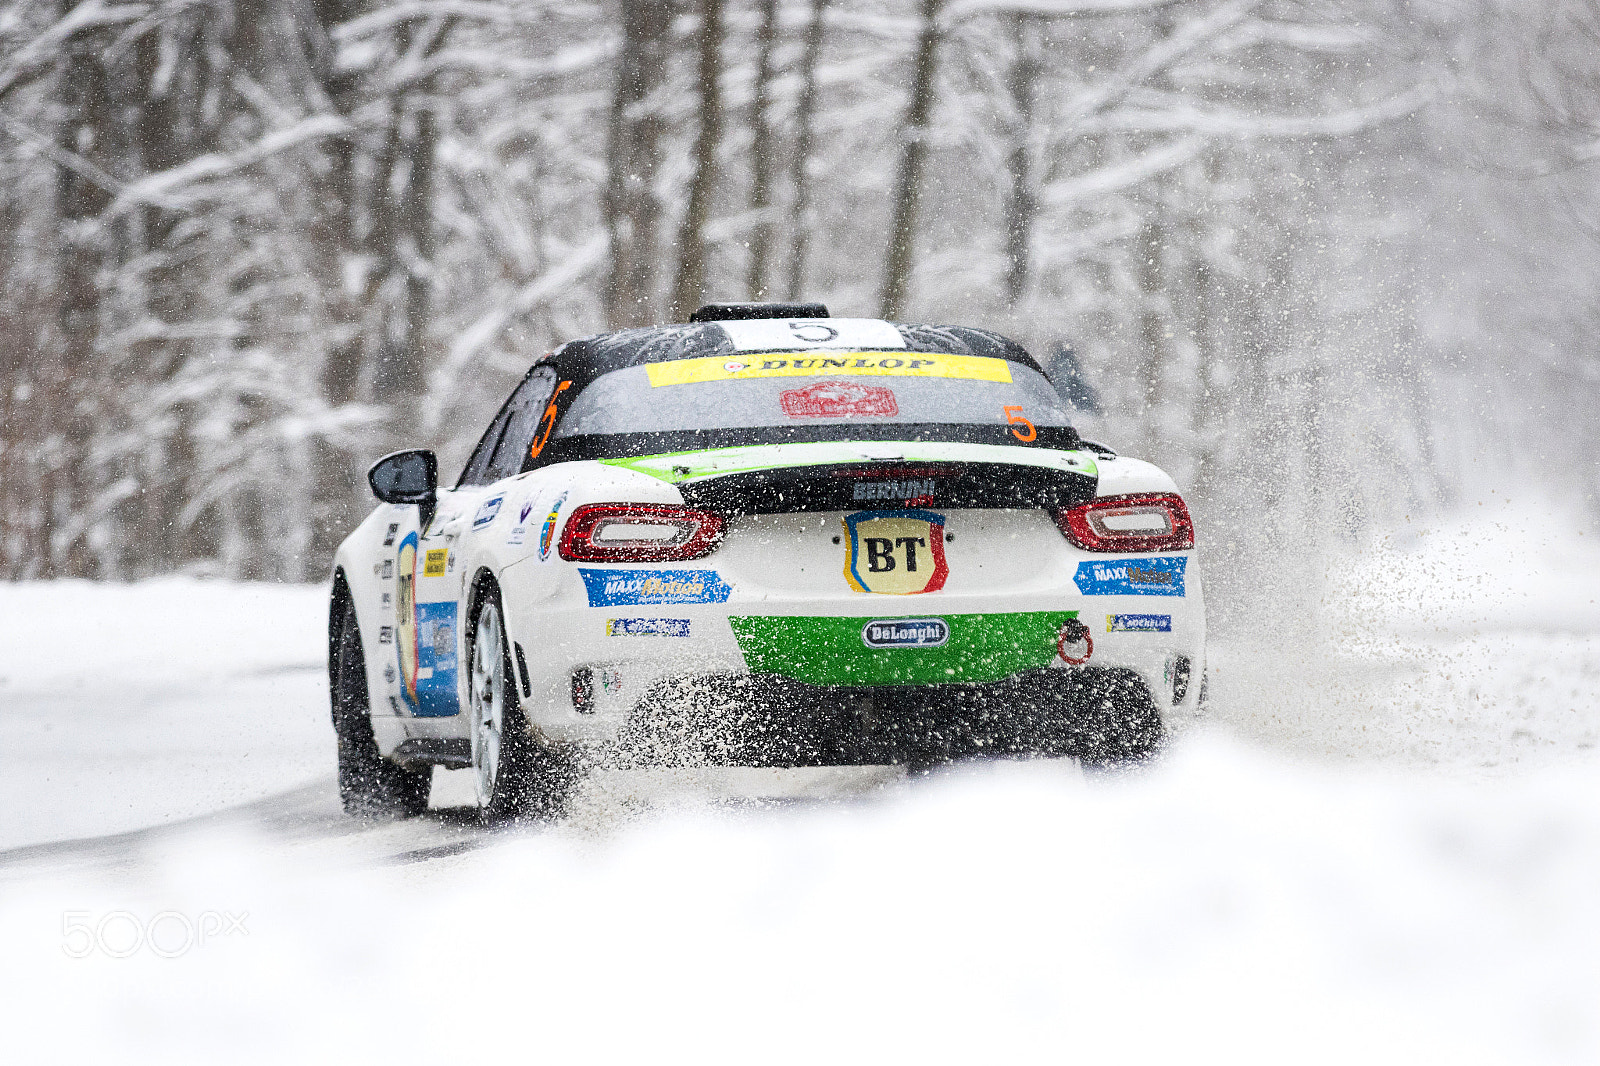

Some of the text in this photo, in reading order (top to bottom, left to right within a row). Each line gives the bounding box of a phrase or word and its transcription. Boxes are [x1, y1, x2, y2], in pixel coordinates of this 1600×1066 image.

[789, 321, 838, 342] 5
[758, 358, 936, 371] DUNLOP
[531, 380, 573, 459] 5
[1003, 405, 1037, 442] 5
[853, 479, 936, 500] BERNINI
[864, 537, 926, 572] BT
[1094, 566, 1129, 581] MAXX
[604, 578, 643, 595] MAXX
